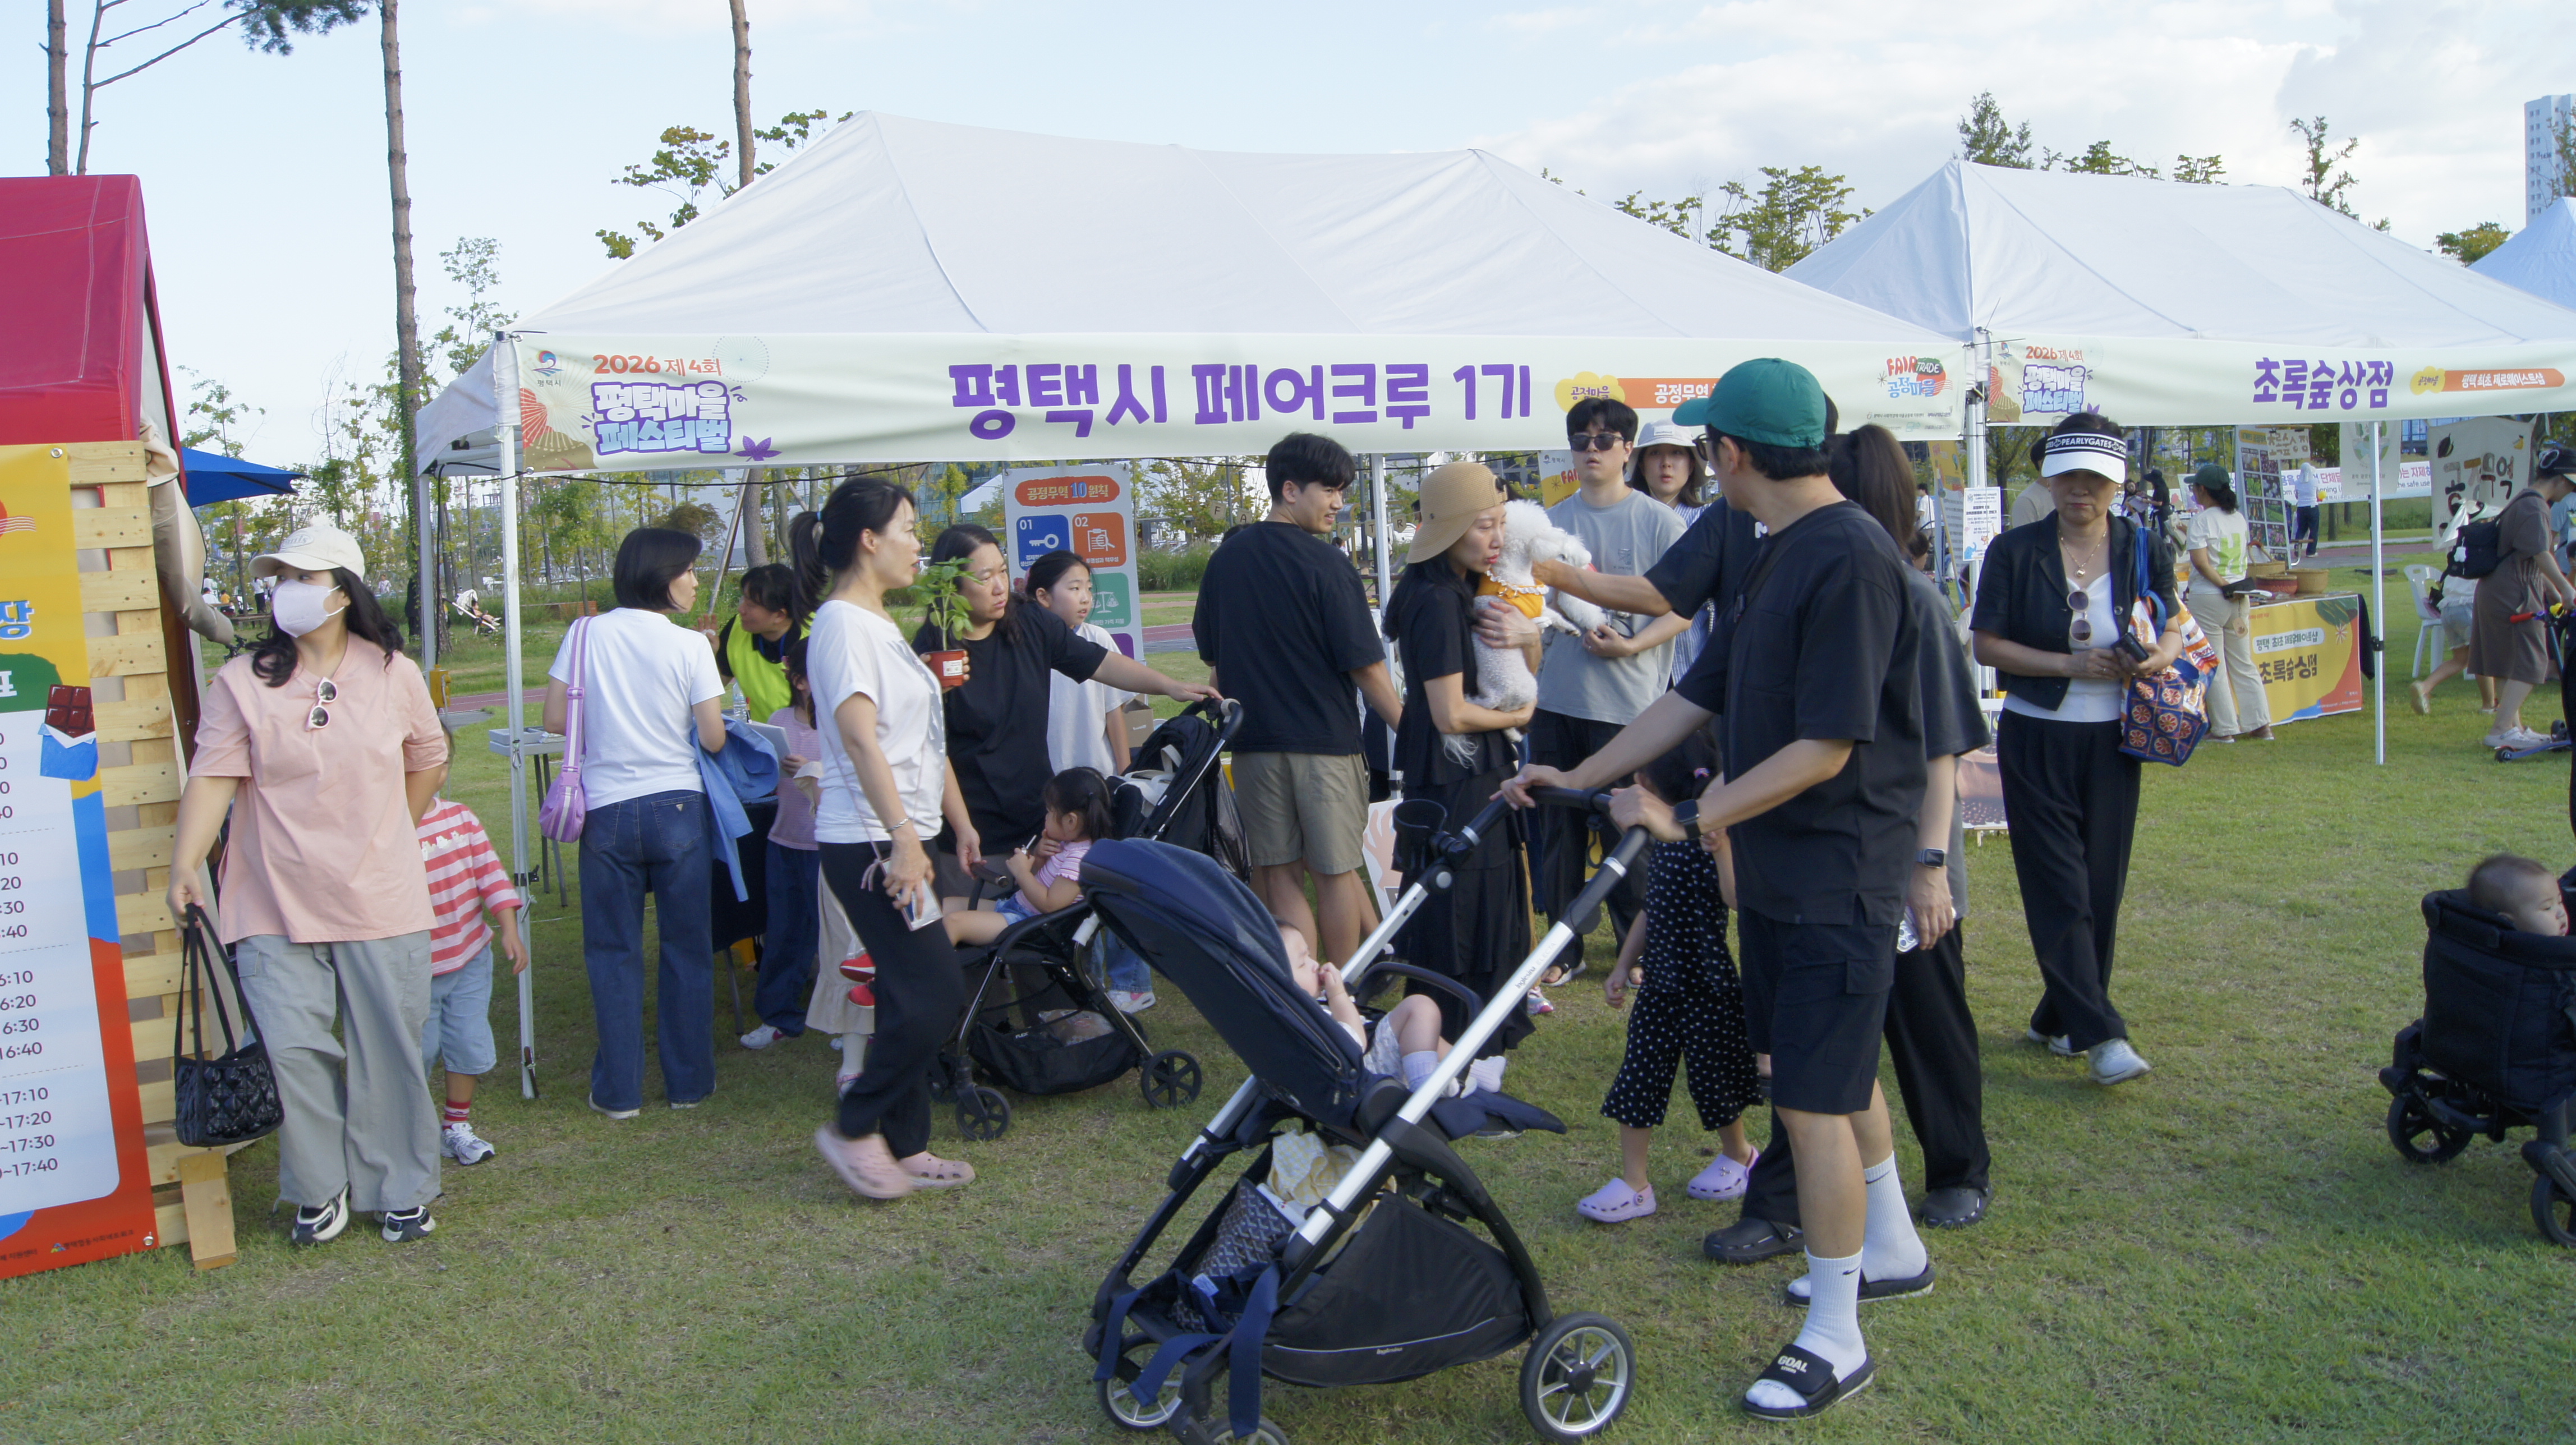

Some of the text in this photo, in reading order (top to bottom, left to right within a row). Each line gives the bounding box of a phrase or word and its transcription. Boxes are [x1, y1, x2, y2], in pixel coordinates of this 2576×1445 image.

[2026, 346, 2058, 360] 2026
[592, 355, 661, 374] 2026
[1886, 356, 1940, 376] FAIR TRADE
[1887, 377, 1936, 398] 공정마을
[2024, 365, 2086, 392] 평택마을
[2253, 357, 2394, 410] 초록숲상점
[2462, 372, 2546, 389] 평택 최초 제로웨이스트샵
[592, 381, 728, 422] 평택마을
[948, 362, 1531, 440] 평택시 페어크루 1기
[2023, 390, 2084, 414] 페스티벌
[595, 418, 729, 454] 페스티벌
[2061, 438, 2112, 449] PEARLYGATES
[1561, 468, 1580, 485] FAI
[1027, 481, 1109, 500] 공정무역 10 원칙
[1019, 519, 1033, 531] 01
[1074, 517, 1089, 528] 02
[1214, 506, 1221, 515] F
[1240, 513, 1247, 522] A
[1397, 519, 1404, 528] R
[2256, 638, 2270, 651] 평택
[2271, 636, 2284, 647] 최초
[0, 924, 27, 938] :40
[1515, 966, 1536, 989] Inglesina
[0, 994, 36, 1010] 6:20
[0, 1087, 49, 1106] 17:10
[0, 1158, 58, 1179] ~17:40
[1777, 1355, 1807, 1373] GOAL
